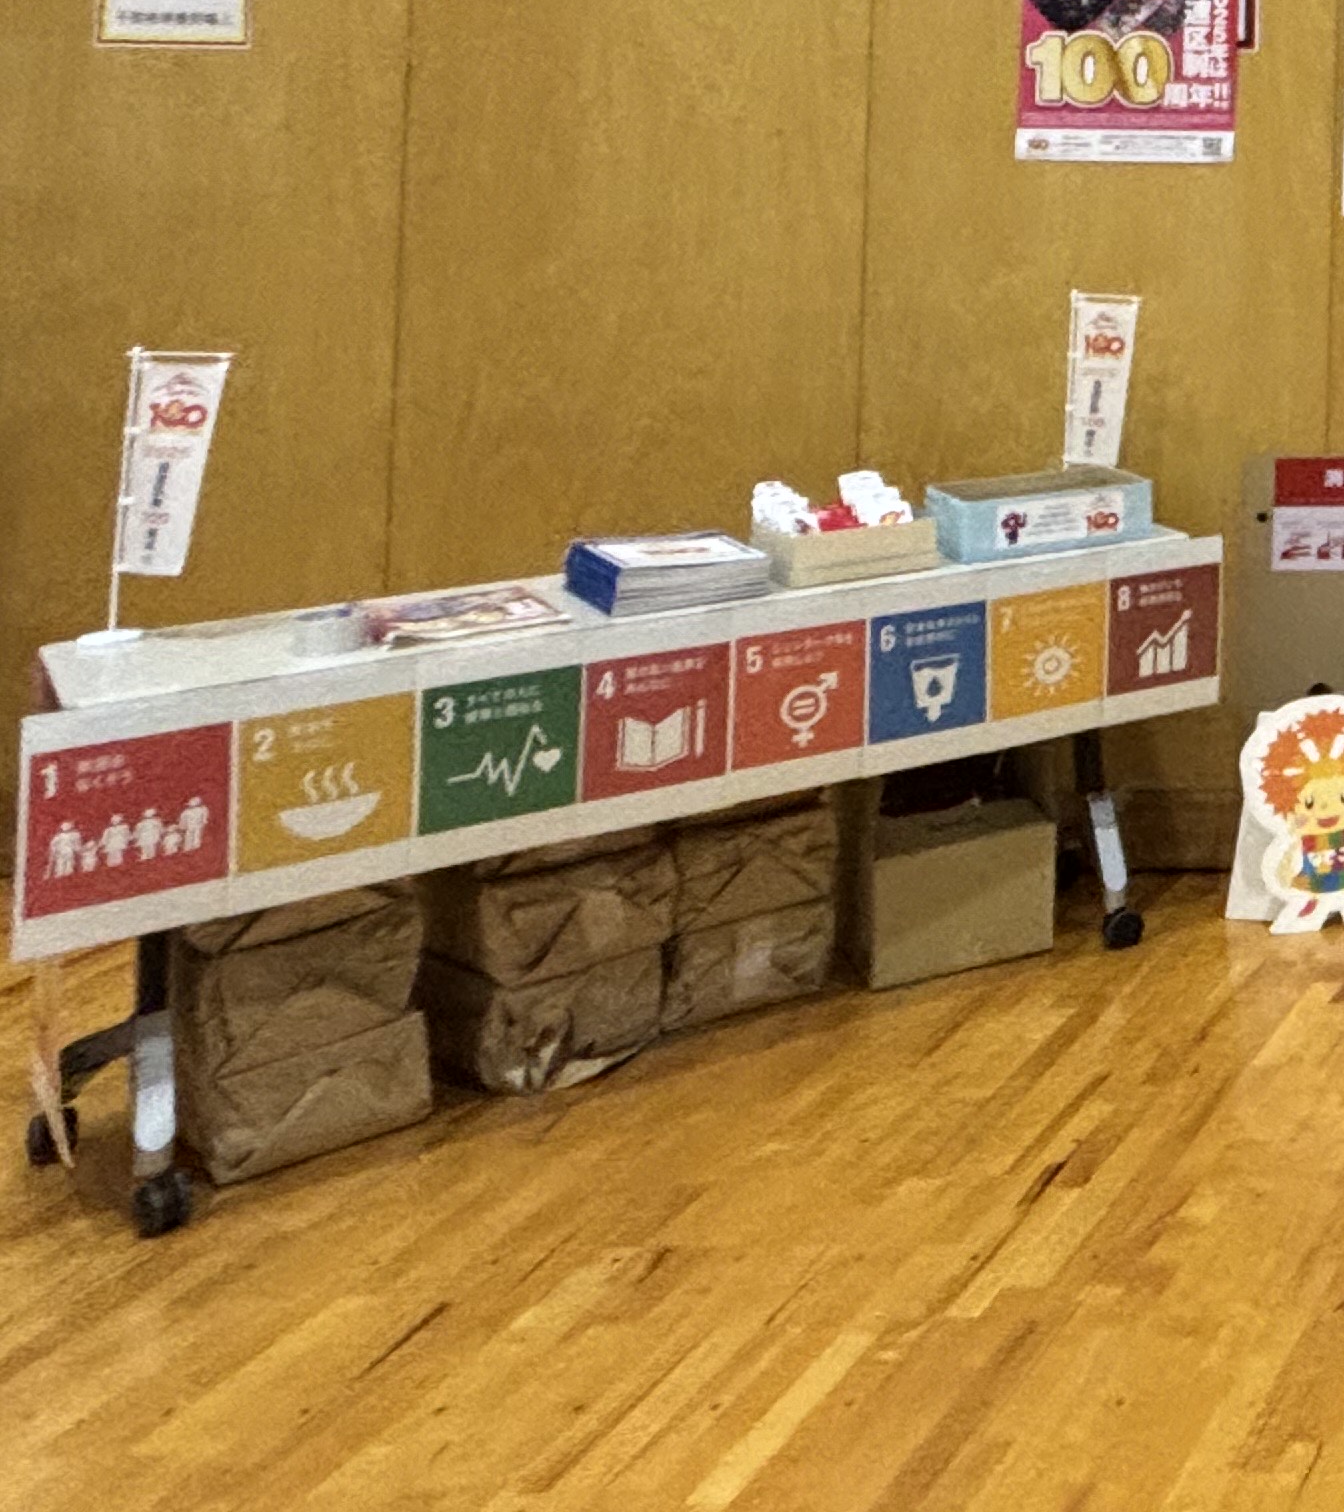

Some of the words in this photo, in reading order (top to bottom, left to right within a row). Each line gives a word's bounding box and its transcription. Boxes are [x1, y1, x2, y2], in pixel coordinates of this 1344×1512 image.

[1027, 30, 1175, 108] 100
[1117, 584, 1131, 612] 8
[880, 625, 896, 652] 6
[746, 645, 763, 673] 5
[596, 671, 615, 699] 4
[434, 696, 456, 729] 3
[253, 728, 276, 762] 2
[40, 763, 58, 799] 1
